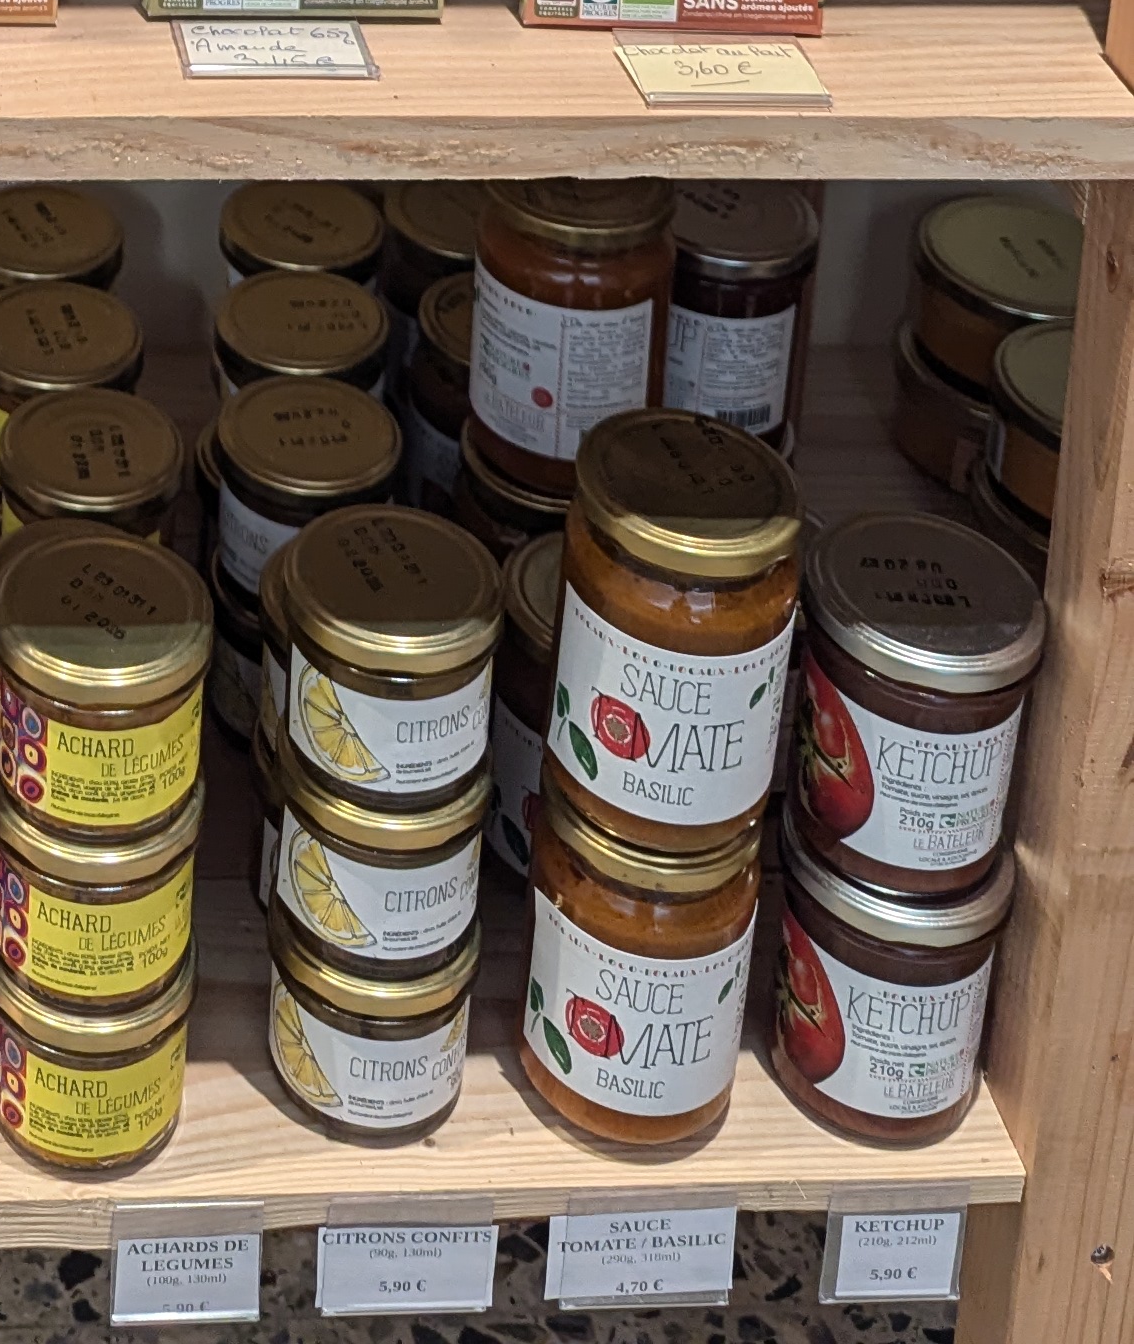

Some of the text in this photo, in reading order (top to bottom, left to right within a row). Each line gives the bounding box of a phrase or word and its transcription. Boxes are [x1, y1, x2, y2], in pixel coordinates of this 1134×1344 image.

[620, 663, 712, 716] SAUCE
[396, 705, 470, 745] CITRONS
[57, 732, 134, 759] ACHARD
[101, 733, 183, 778] DE LÉGUMES
[877, 735, 1003, 786] KETCHUP
[623, 771, 694, 806] BASILIC
[899, 815, 934, 830] 210g
[609, 1218, 671, 1233] SAUCE
[855, 1219, 944, 1233] KETCHUP
[127, 1239, 249, 1256] ACHARDS DE
[322, 1230, 492, 1245] CITRONS CONFITS
[558, 1238, 636, 1253] TOMATE
[652, 1233, 726, 1248] BASILIC
[142, 1257, 233, 1272] LEGUMES
